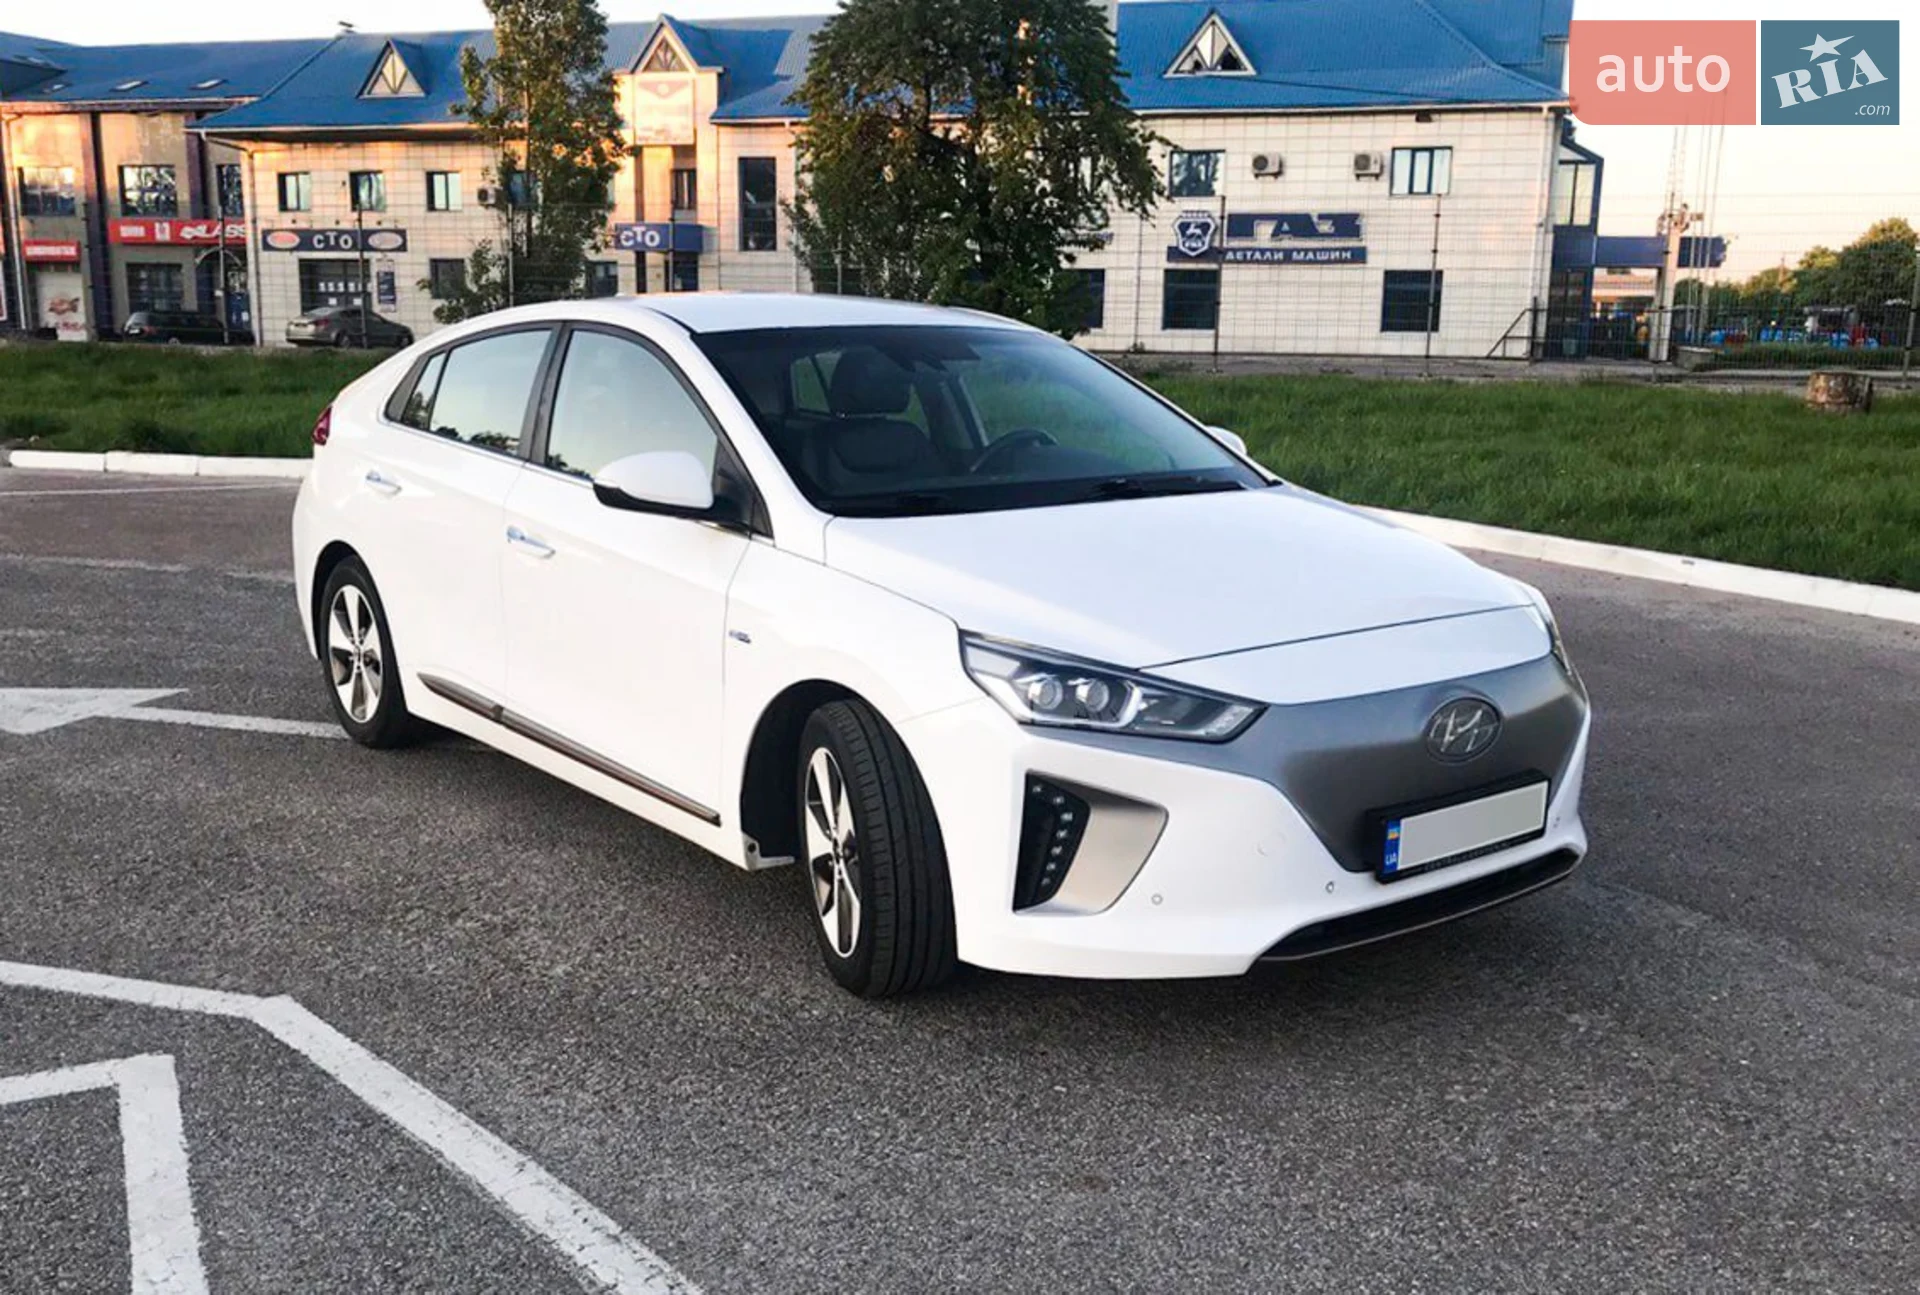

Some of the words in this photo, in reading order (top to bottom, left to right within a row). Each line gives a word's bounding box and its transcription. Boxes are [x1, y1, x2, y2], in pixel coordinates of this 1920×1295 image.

[312, 231, 353, 249] СТО
[620, 226, 661, 247] СТО
[1225, 250, 1285, 261] ДЕТАЛИ
[1292, 250, 1352, 260] МАШИН
